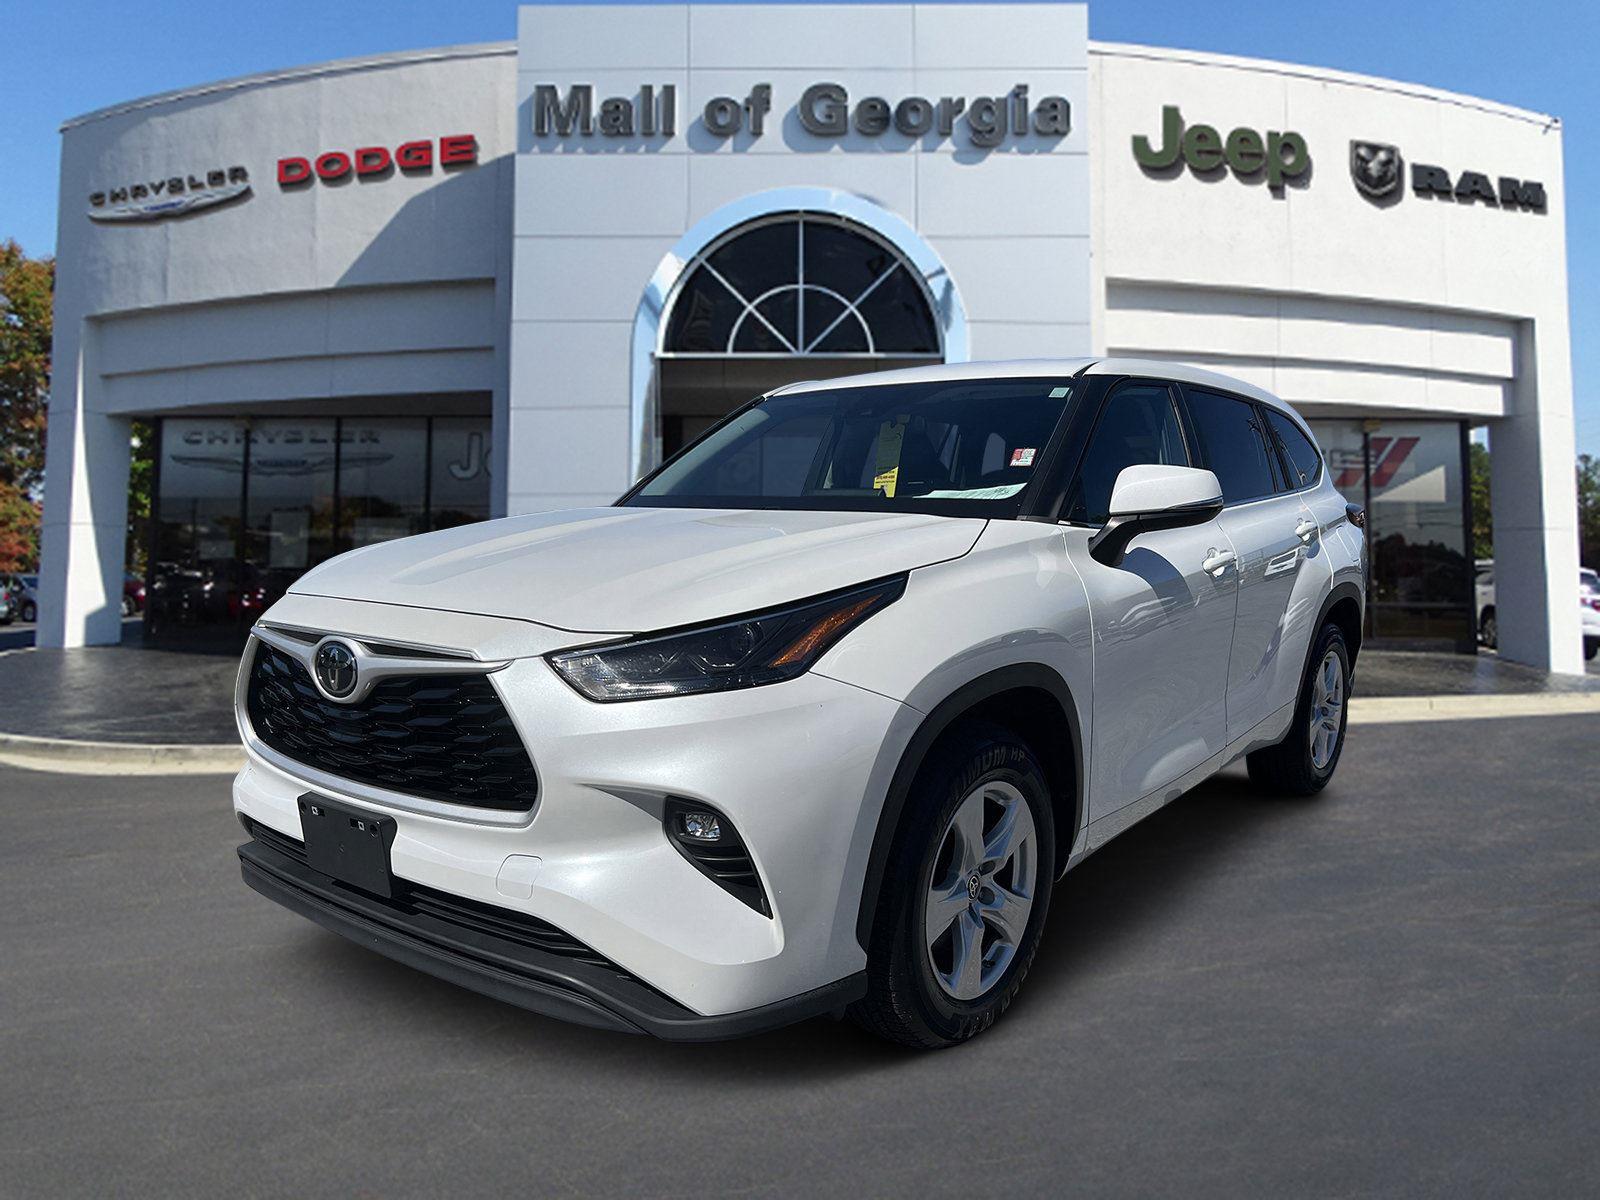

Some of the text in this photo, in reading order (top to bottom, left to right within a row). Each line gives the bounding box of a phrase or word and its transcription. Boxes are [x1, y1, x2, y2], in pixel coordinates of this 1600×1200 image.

[533, 82, 1071, 148] Mall of Georgia
[277, 134, 477, 187] DODGE
[1132, 105, 1309, 193] Jeep
[89, 166, 248, 206] CHRYSLER
[1411, 162, 1547, 214] RAM
